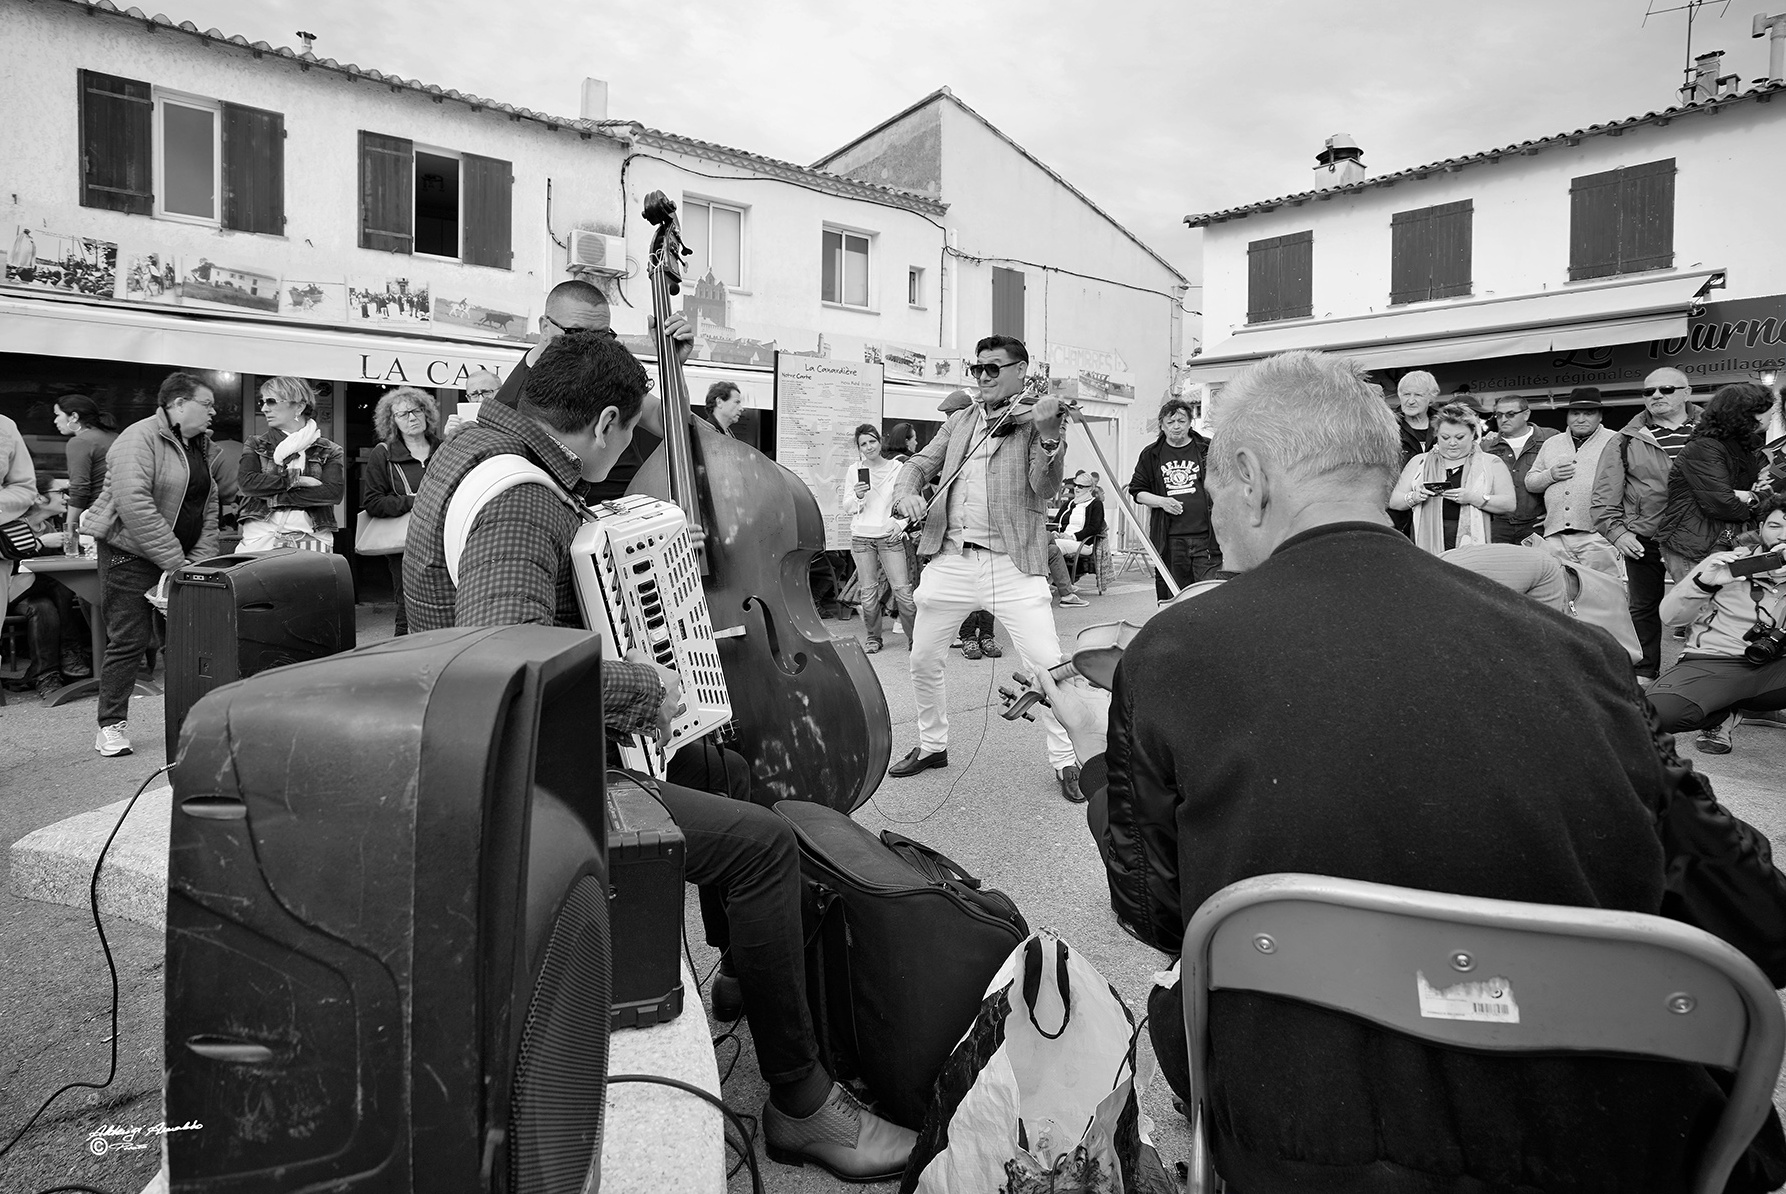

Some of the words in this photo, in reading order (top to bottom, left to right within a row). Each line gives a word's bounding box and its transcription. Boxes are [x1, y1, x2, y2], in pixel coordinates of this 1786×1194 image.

[1648, 307, 1786, 360] ourn
[359, 354, 410, 382] LA
[804, 363, 815, 372] La
[816, 364, 858, 376] Canardière
[1470, 374, 1549, 391] Spécialités
[1555, 367, 1642, 386] régionales
[1674, 355, 1786, 376] oquillags
